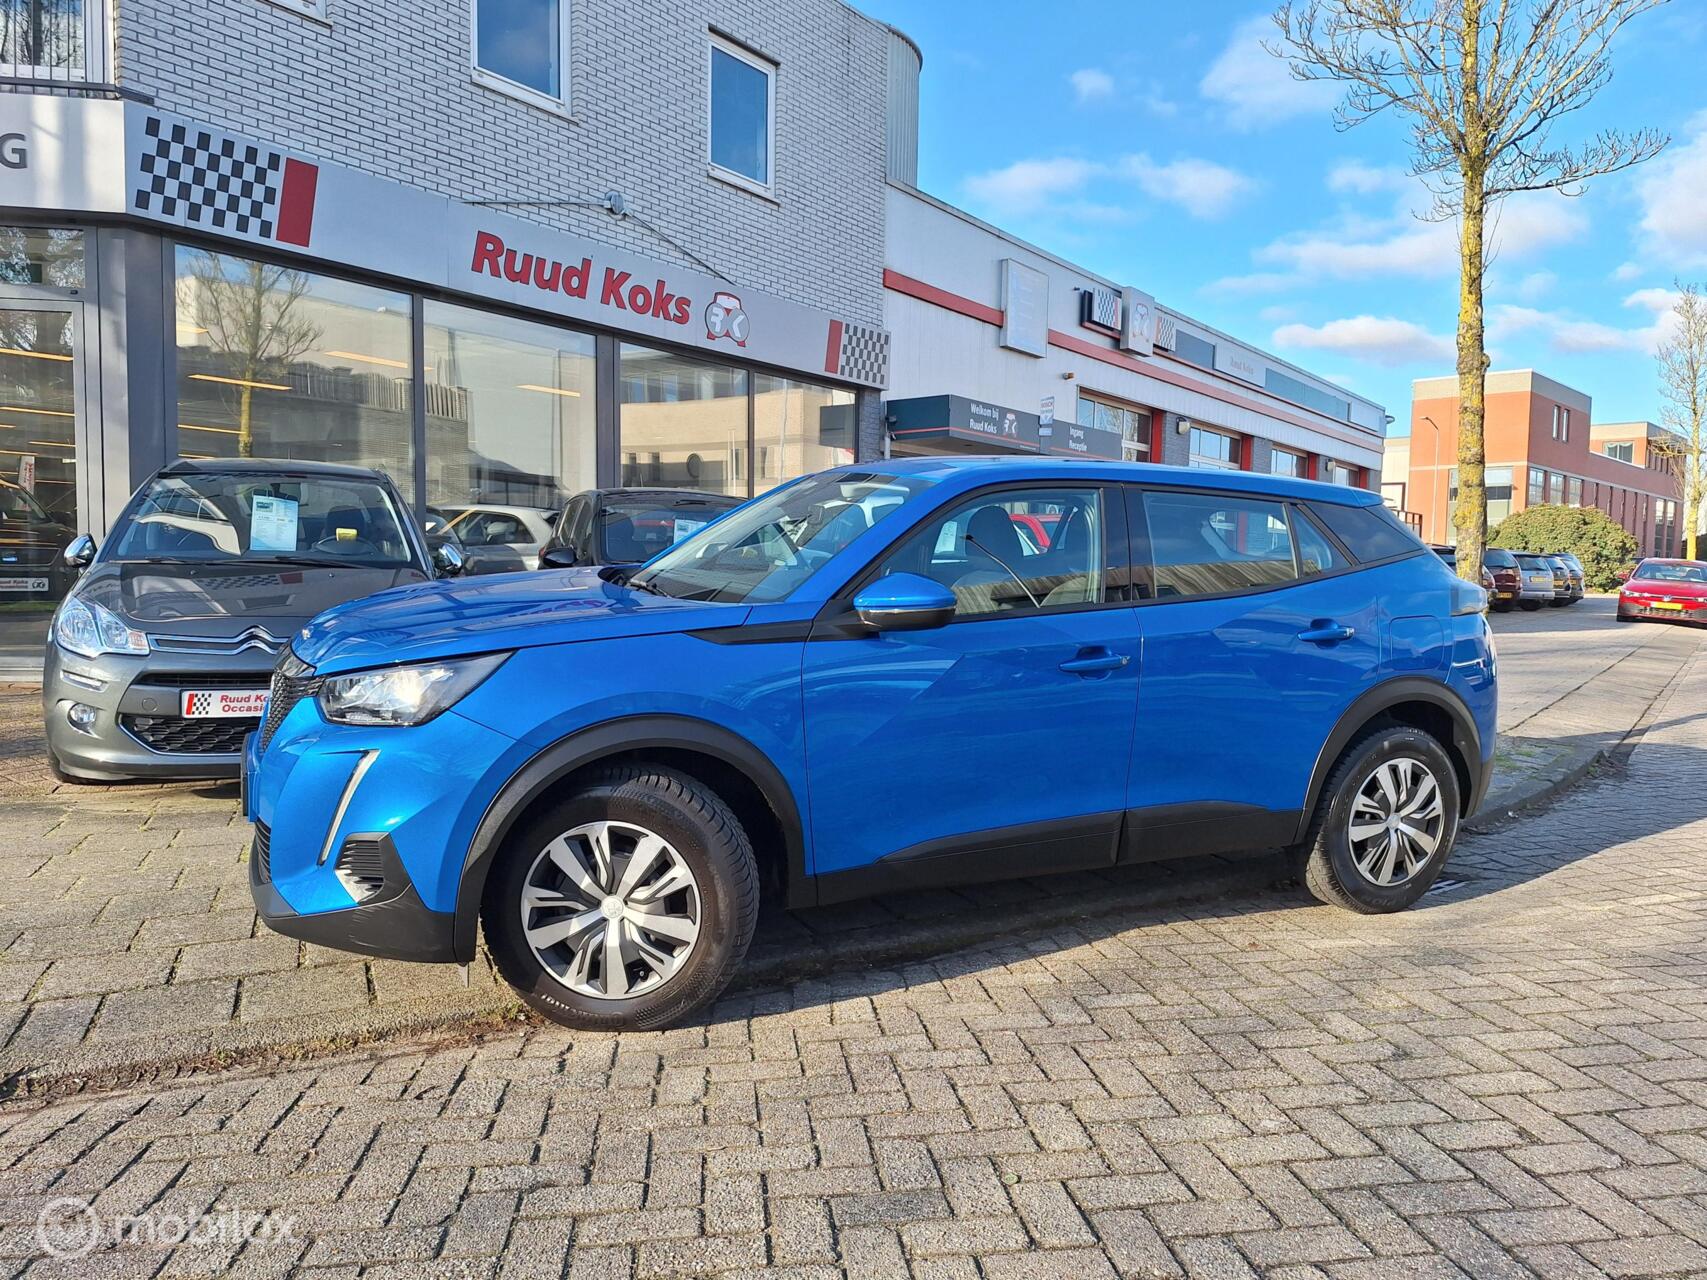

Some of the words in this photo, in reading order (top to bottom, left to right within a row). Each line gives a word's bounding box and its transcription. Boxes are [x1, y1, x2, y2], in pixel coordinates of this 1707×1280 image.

[471, 230, 592, 300] Ruud
[600, 266, 692, 324] Koks
[970, 402, 992, 417] Welkom
[992, 407, 1000, 421] bij
[969, 418, 984, 431] Ruud
[984, 421, 998, 434] Koks
[1069, 425, 1084, 440] Ingang
[1069, 439, 1088, 452] Receptie
[219, 694, 252, 704] Ruud
